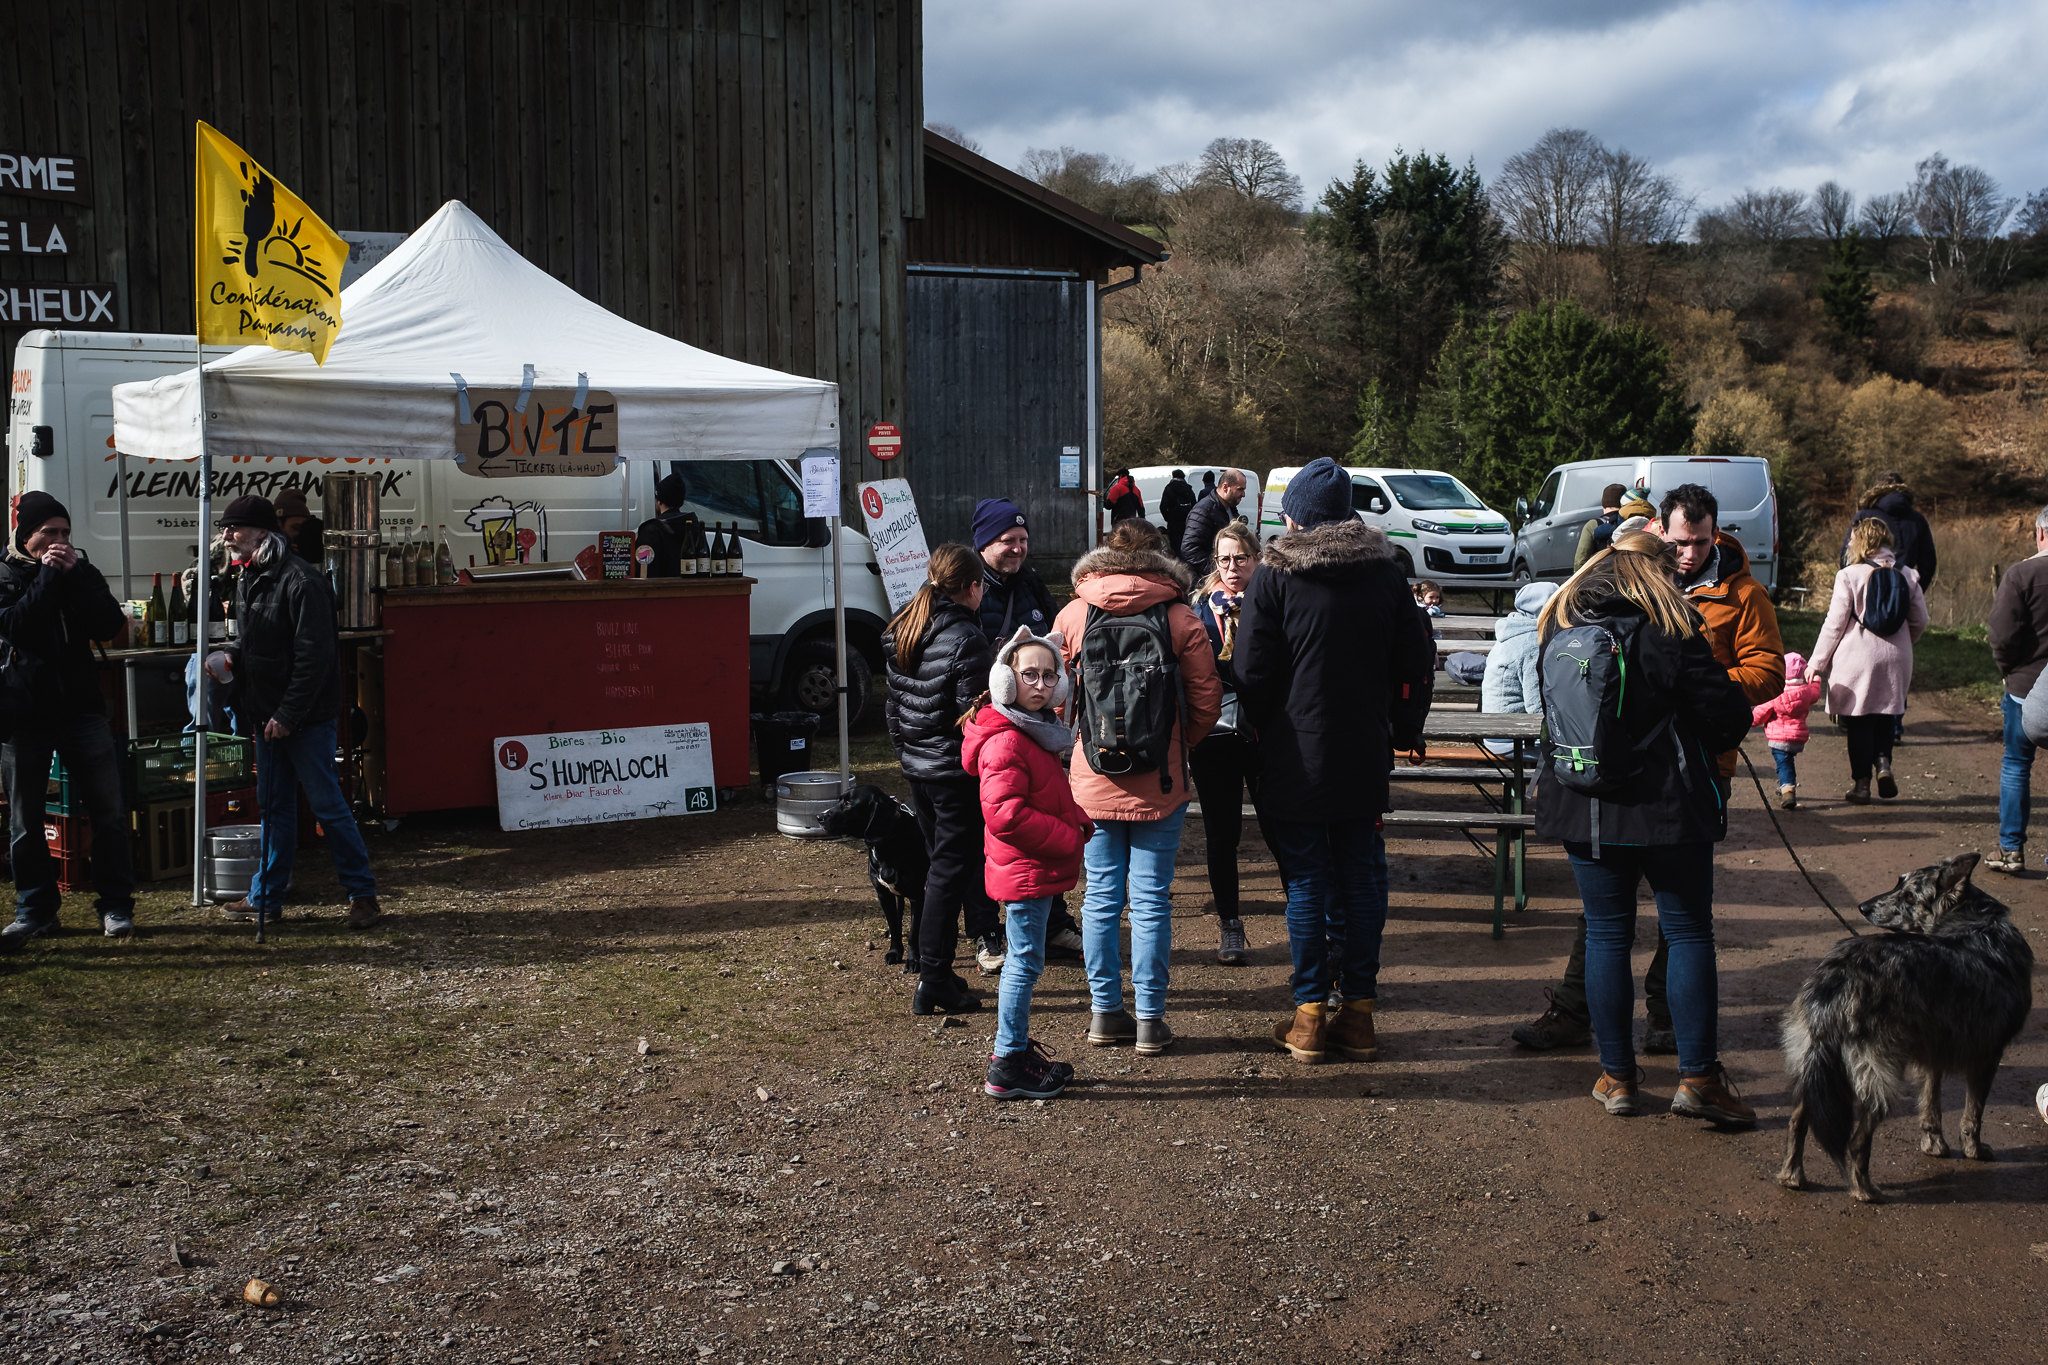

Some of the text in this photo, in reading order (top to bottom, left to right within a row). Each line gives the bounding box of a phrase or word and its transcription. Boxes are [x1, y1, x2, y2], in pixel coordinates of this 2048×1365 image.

[20, 222, 68, 253] LA
[210, 281, 337, 328] Confédération
[473, 400, 617, 459] BUVETTE
[506, 459, 555, 474] TICKETS
[548, 731, 626, 750] Bières Bio
[529, 753, 670, 791] S'HUMPALOCH
[589, 784, 624, 798] Fawrek
